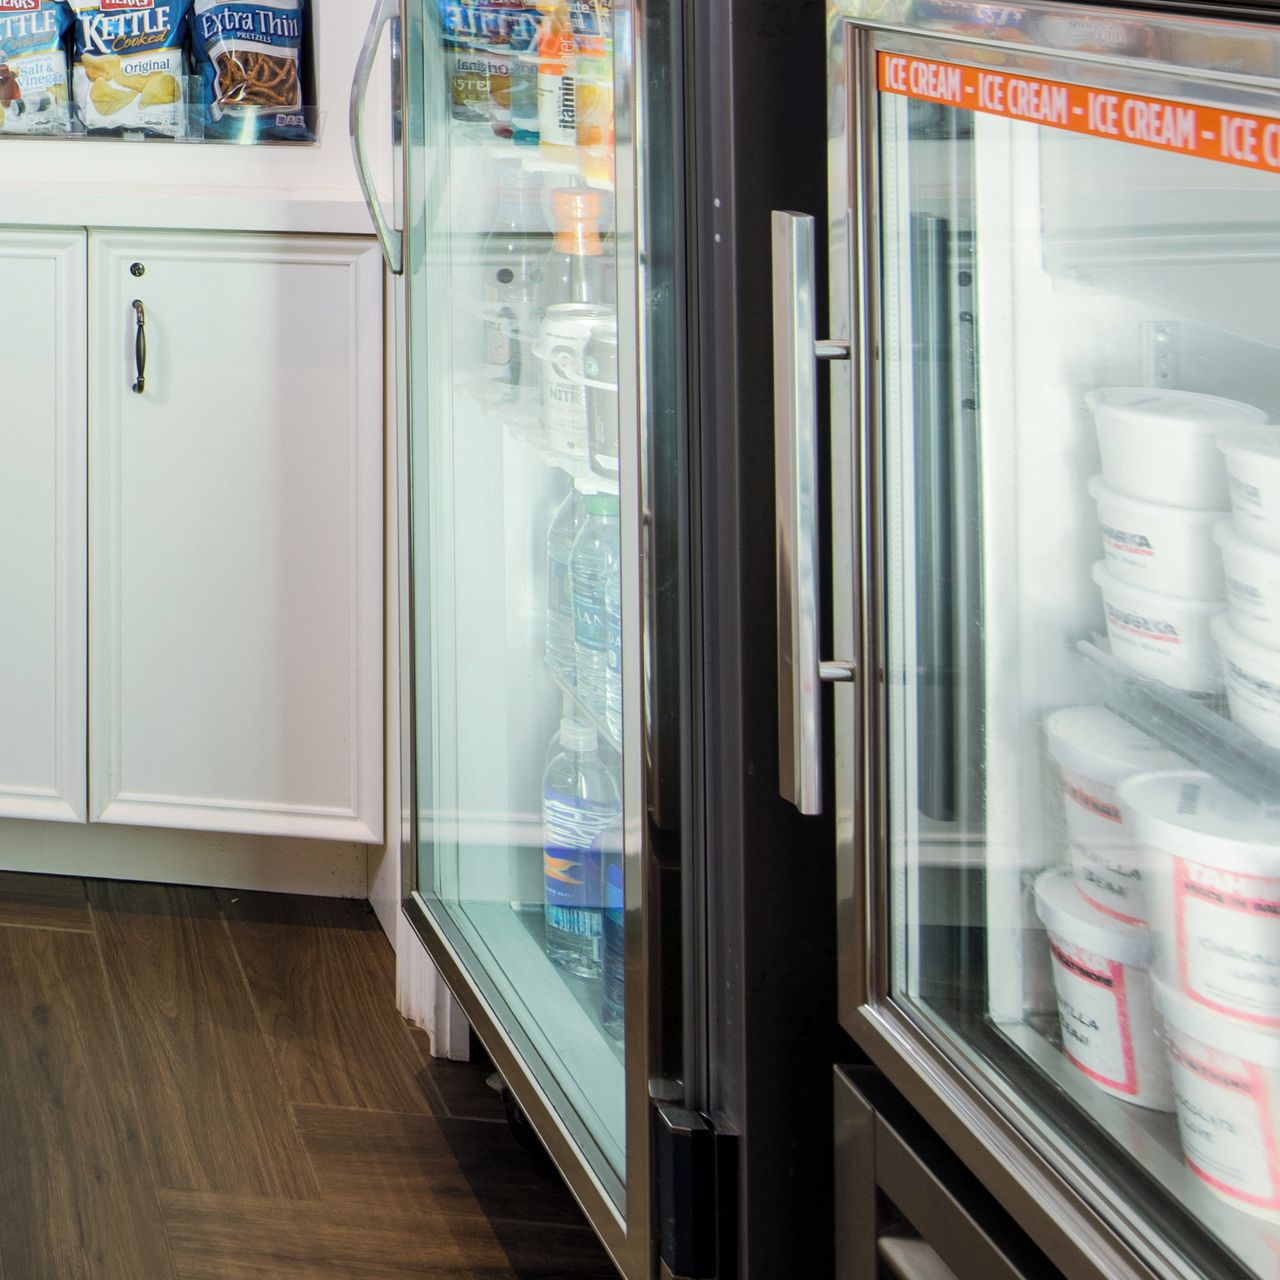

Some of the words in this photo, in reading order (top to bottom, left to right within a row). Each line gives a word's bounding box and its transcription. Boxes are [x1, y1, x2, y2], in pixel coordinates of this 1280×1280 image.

[81, 5, 172, 55] KETTLE
[202, 6, 254, 39] Extra
[255, 9, 299, 39] Thin
[110, 29, 167, 53] Cooked
[236, 30, 272, 44] PRETZELS
[19, 63, 44, 76] Salt
[123, 57, 171, 75] Original
[17, 72, 65, 88] Vinegar
[884, 56, 907, 91] ICE
[909, 60, 961, 102] CREAM
[978, 72, 1005, 112] ICE
[1007, 78, 1069, 125] CREAM
[1088, 92, 1119, 135] ICE
[1122, 99, 1197, 151] CREAM
[1220, 114, 1259, 163] ICE
